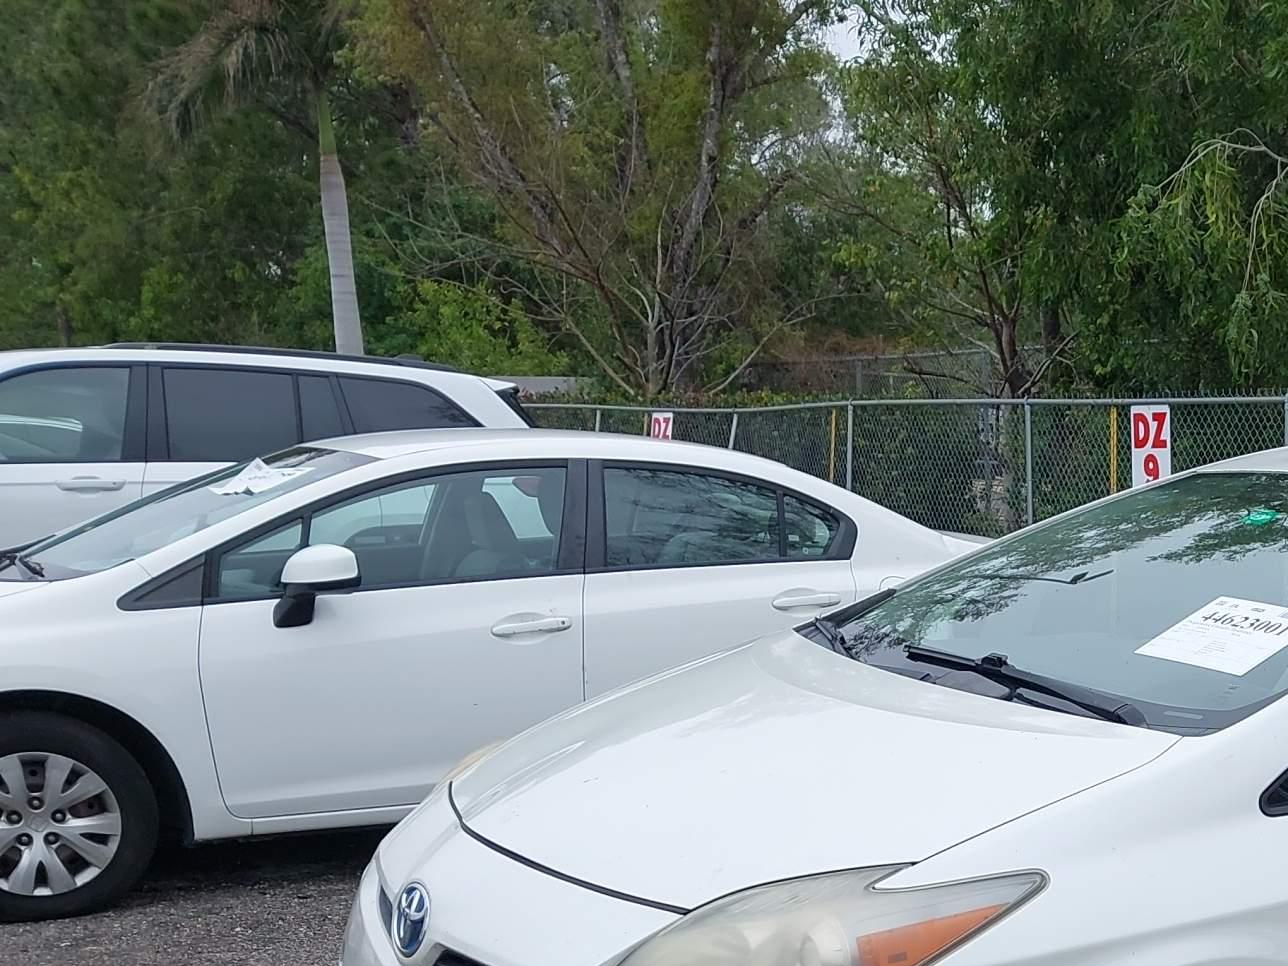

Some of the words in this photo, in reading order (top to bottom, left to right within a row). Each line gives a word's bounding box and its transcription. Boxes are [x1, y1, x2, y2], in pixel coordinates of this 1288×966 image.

[653, 417, 671, 440] DZ
[1133, 412, 1167, 448] DZ
[1143, 453, 1160, 481] 9
